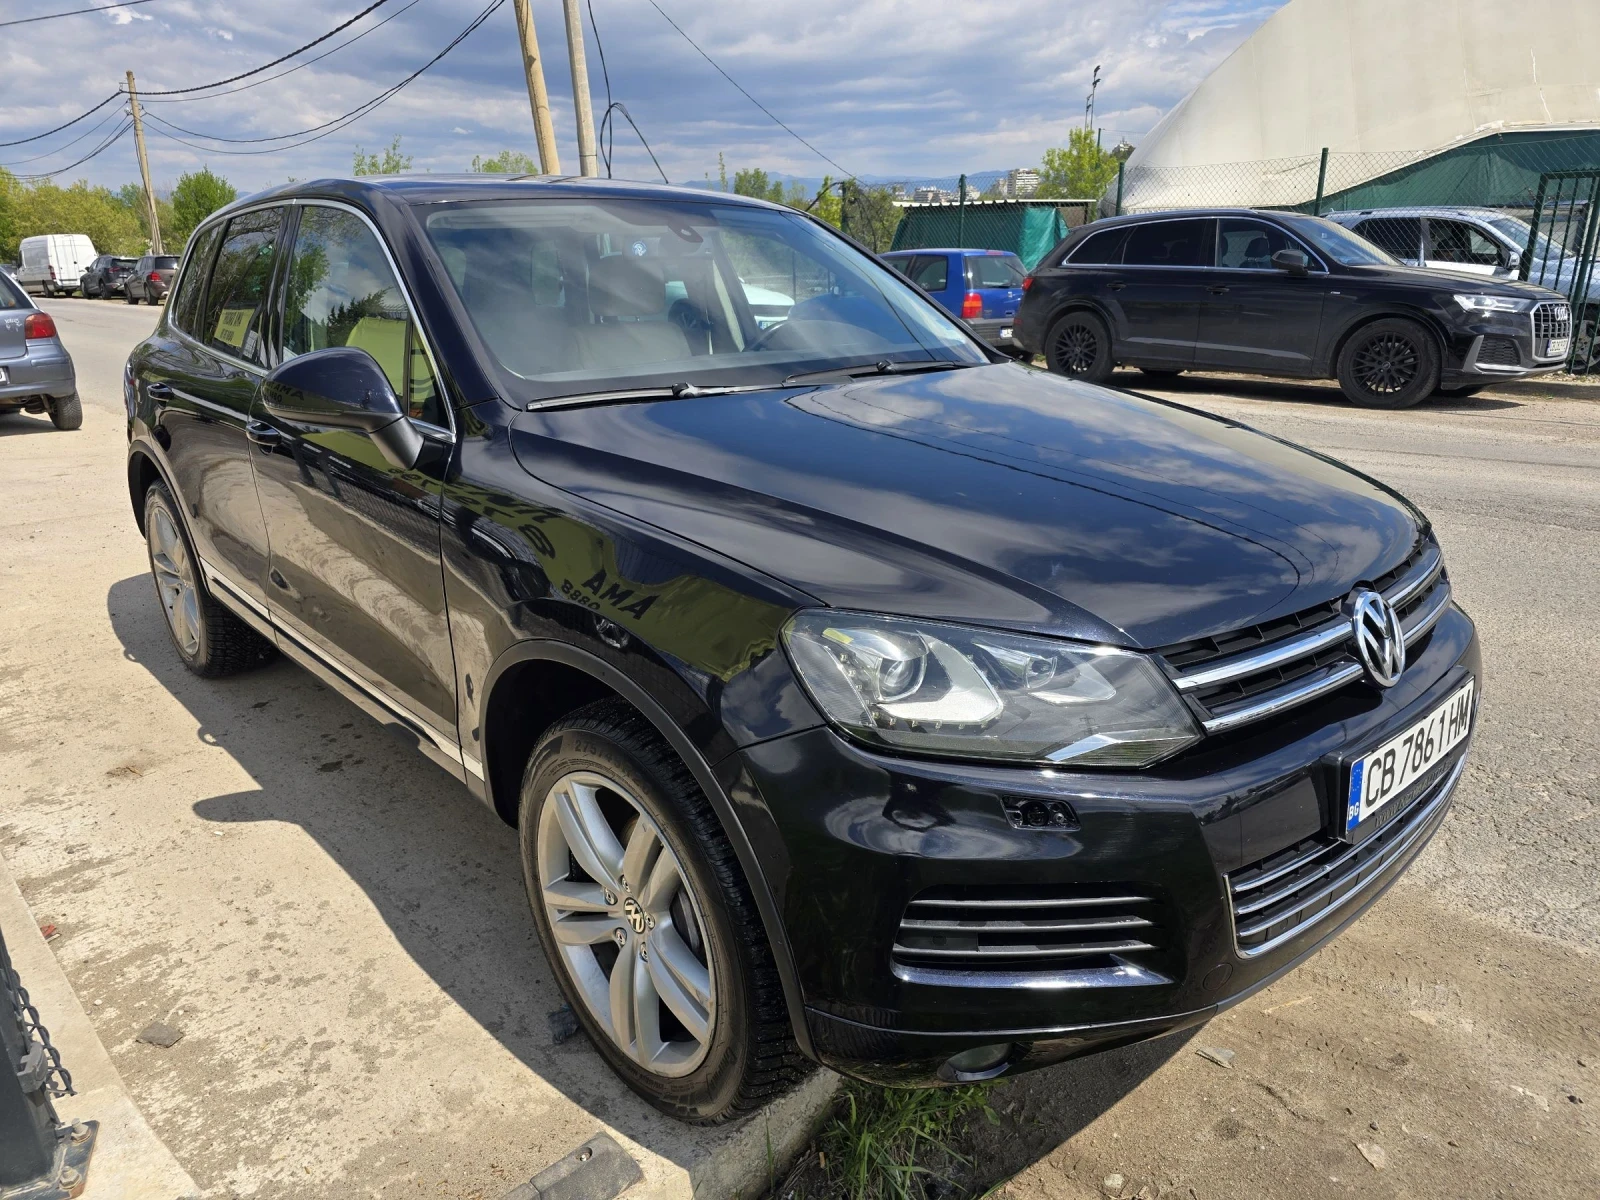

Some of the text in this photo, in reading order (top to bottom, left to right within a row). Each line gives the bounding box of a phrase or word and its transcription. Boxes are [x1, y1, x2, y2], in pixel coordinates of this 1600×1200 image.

[1365, 748, 1396, 807] CB
[1399, 710, 1447, 785] 7861
[1447, 689, 1472, 746] HM
[1348, 801, 1360, 821] BG
